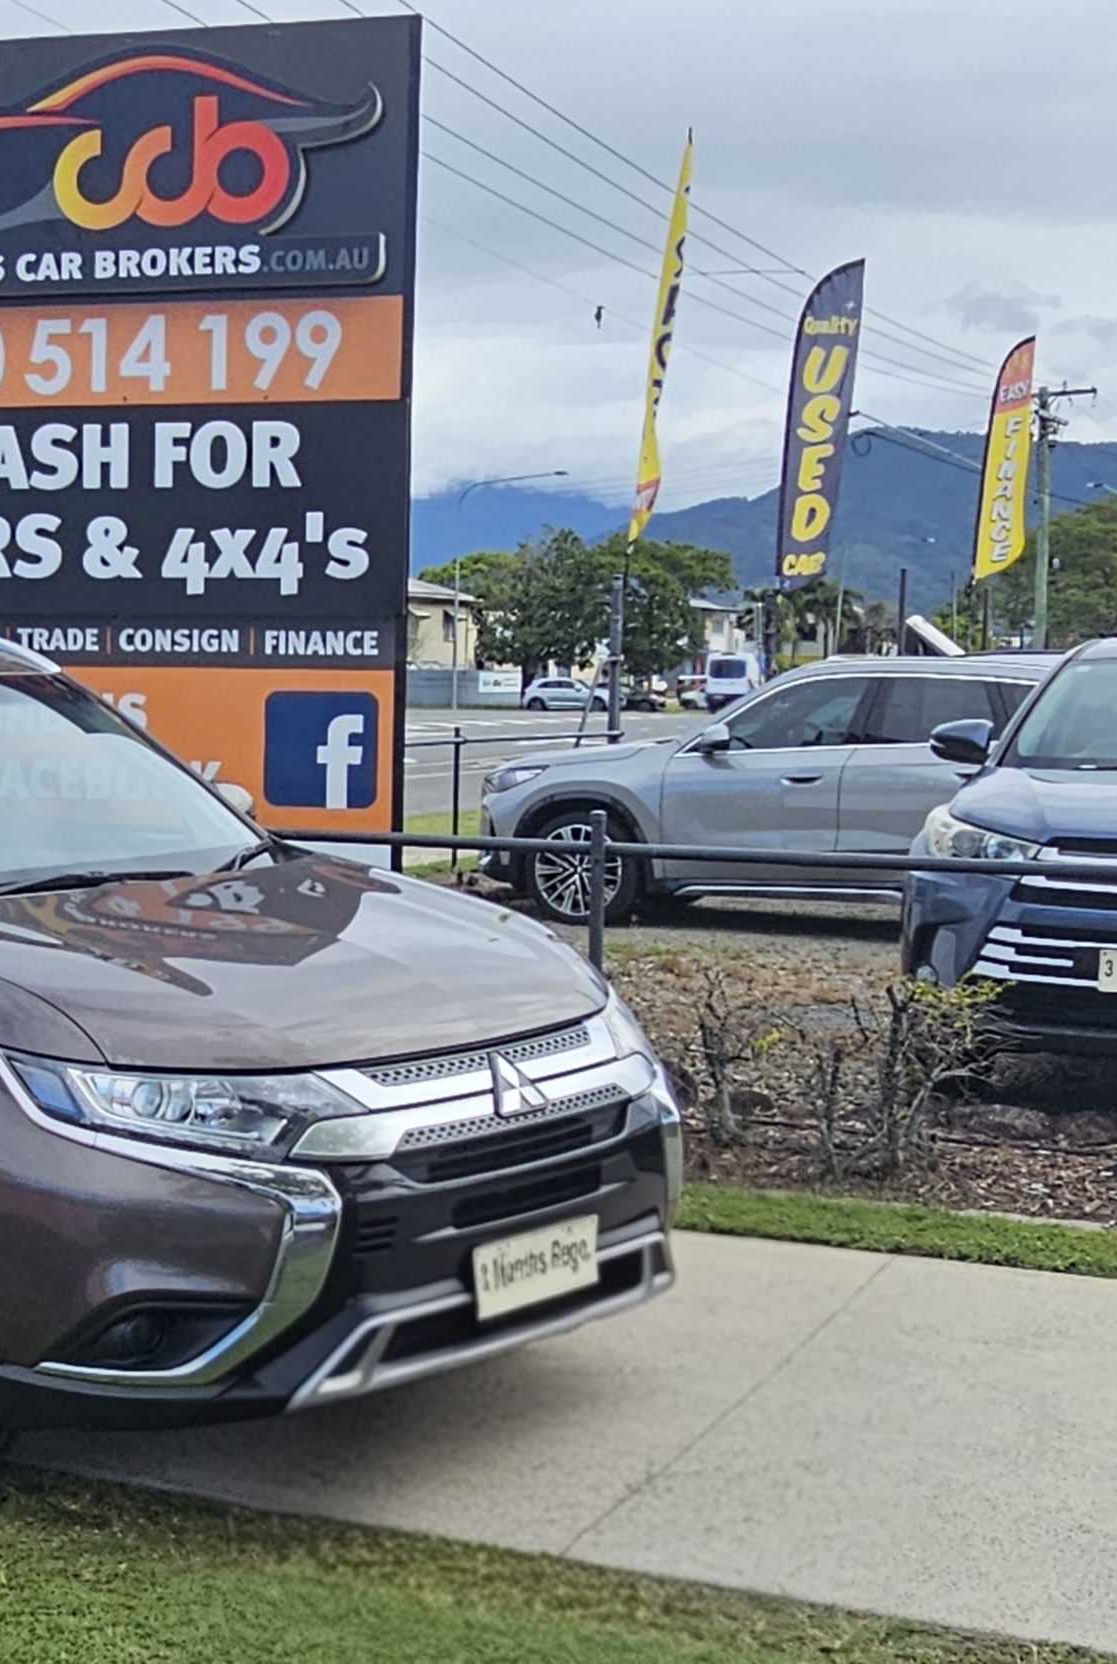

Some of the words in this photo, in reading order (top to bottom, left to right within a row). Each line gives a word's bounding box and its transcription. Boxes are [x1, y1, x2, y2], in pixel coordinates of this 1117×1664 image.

[16, 251, 83, 282] CAR
[24, 313, 171, 393] 514
[198, 310, 343, 391] 199
[153, 420, 302, 489] FOR
[790, 344, 850, 542] USED
[990, 416, 1022, 563] FINANCE
[83, 515, 144, 580] &
[17, 627, 100, 652] TRADE
[118, 628, 240, 653] CONSIGN
[264, 629, 379, 656] FINANCE
